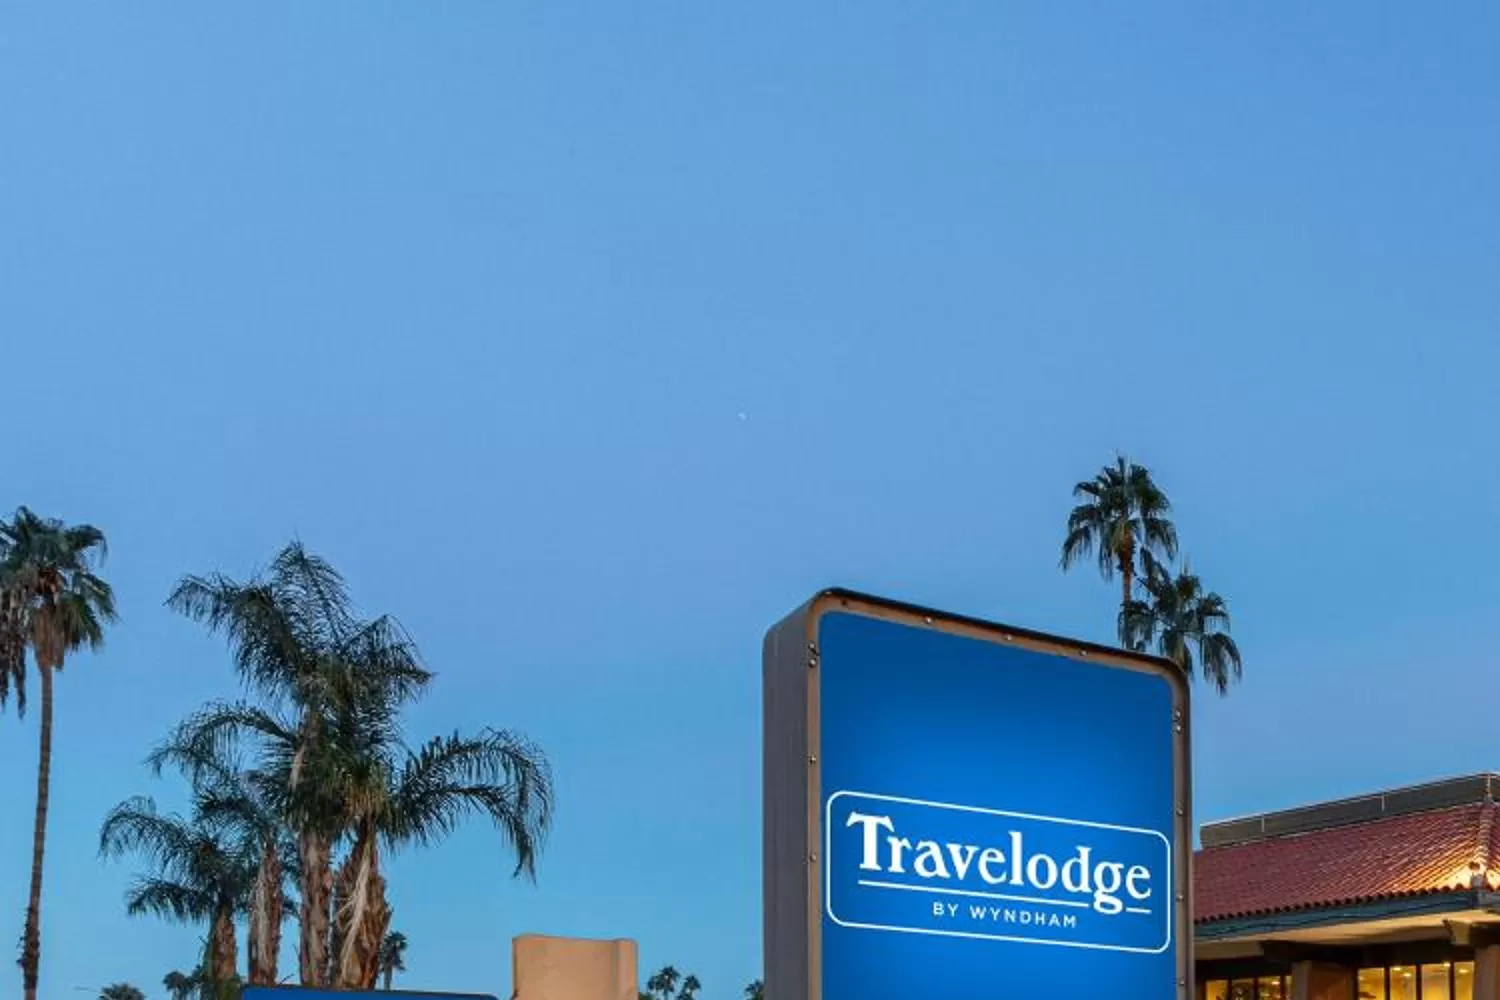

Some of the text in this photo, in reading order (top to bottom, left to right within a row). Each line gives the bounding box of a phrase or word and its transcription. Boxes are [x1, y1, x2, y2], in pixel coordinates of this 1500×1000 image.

[846, 811, 1151, 914] Travelodge
[933, 902, 1077, 928] BY WYNDHAM
